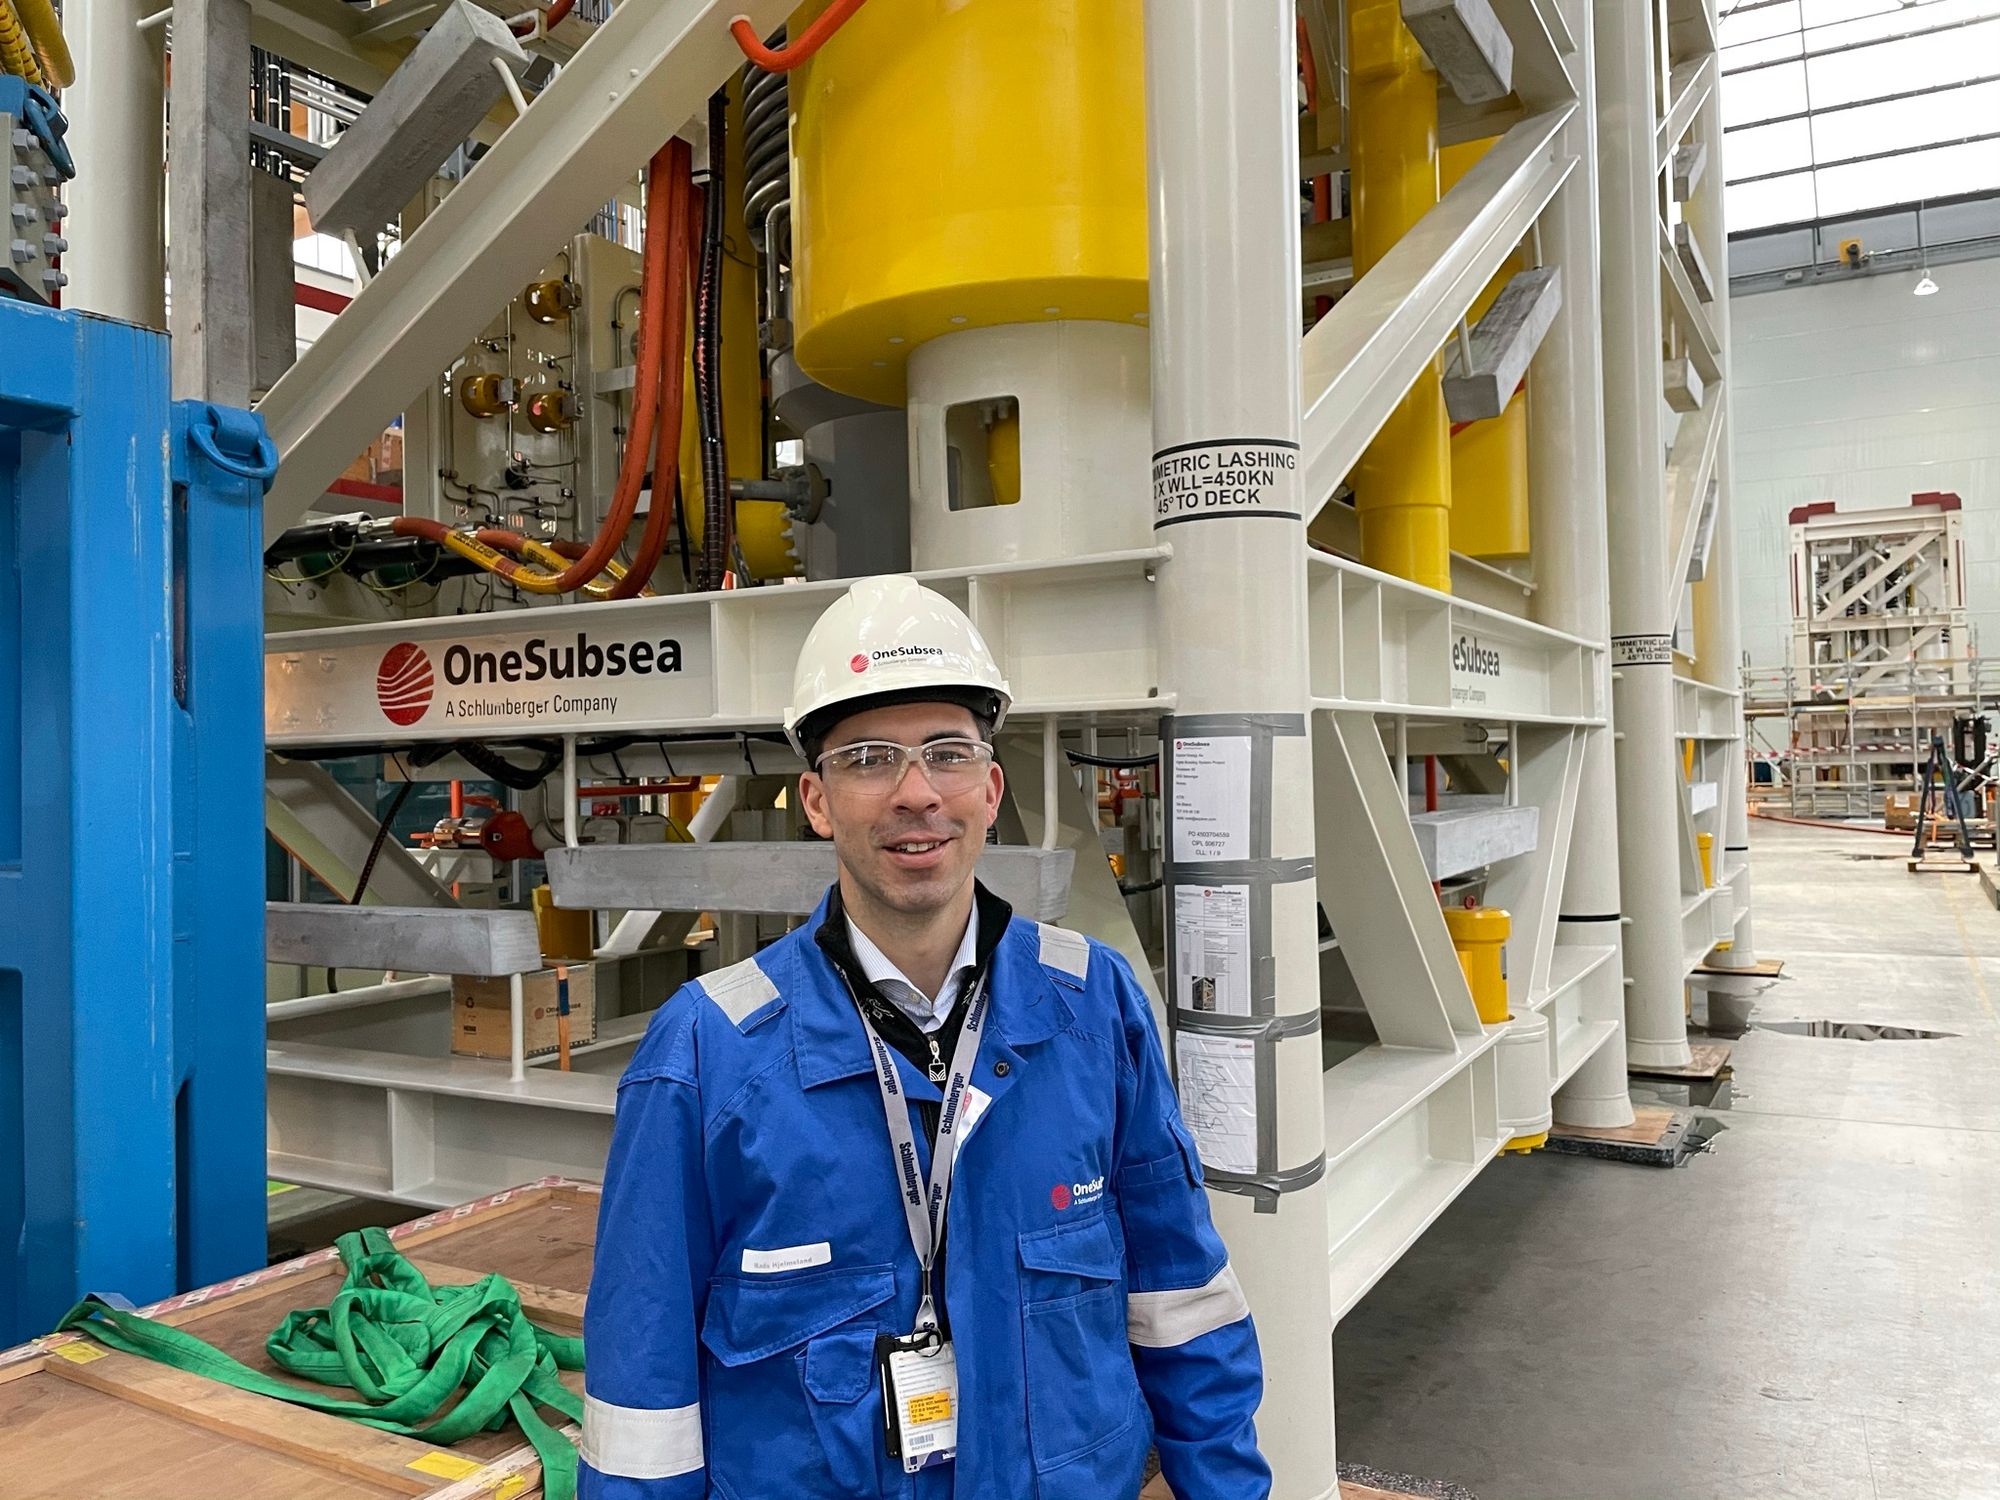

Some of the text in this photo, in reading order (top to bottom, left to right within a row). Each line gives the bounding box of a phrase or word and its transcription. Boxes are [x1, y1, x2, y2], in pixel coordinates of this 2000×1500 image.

[1217, 451, 1295, 470] LASHING
[1157, 488, 1261, 515] 45° TO DECK
[1158, 481, 1166, 498] X
[1168, 470, 1274, 494] WLL=450KN
[443, 632, 683, 686] OneSubsea
[872, 646, 943, 660] OneSubsea
[1452, 635, 1500, 677] eSubsea
[445, 694, 618, 718] A Schlumberger Company
[873, 1036, 898, 1096] Schlumberger
[940, 1072, 965, 1135] Schlumberger
[899, 1141, 921, 1206] Schlumberger
